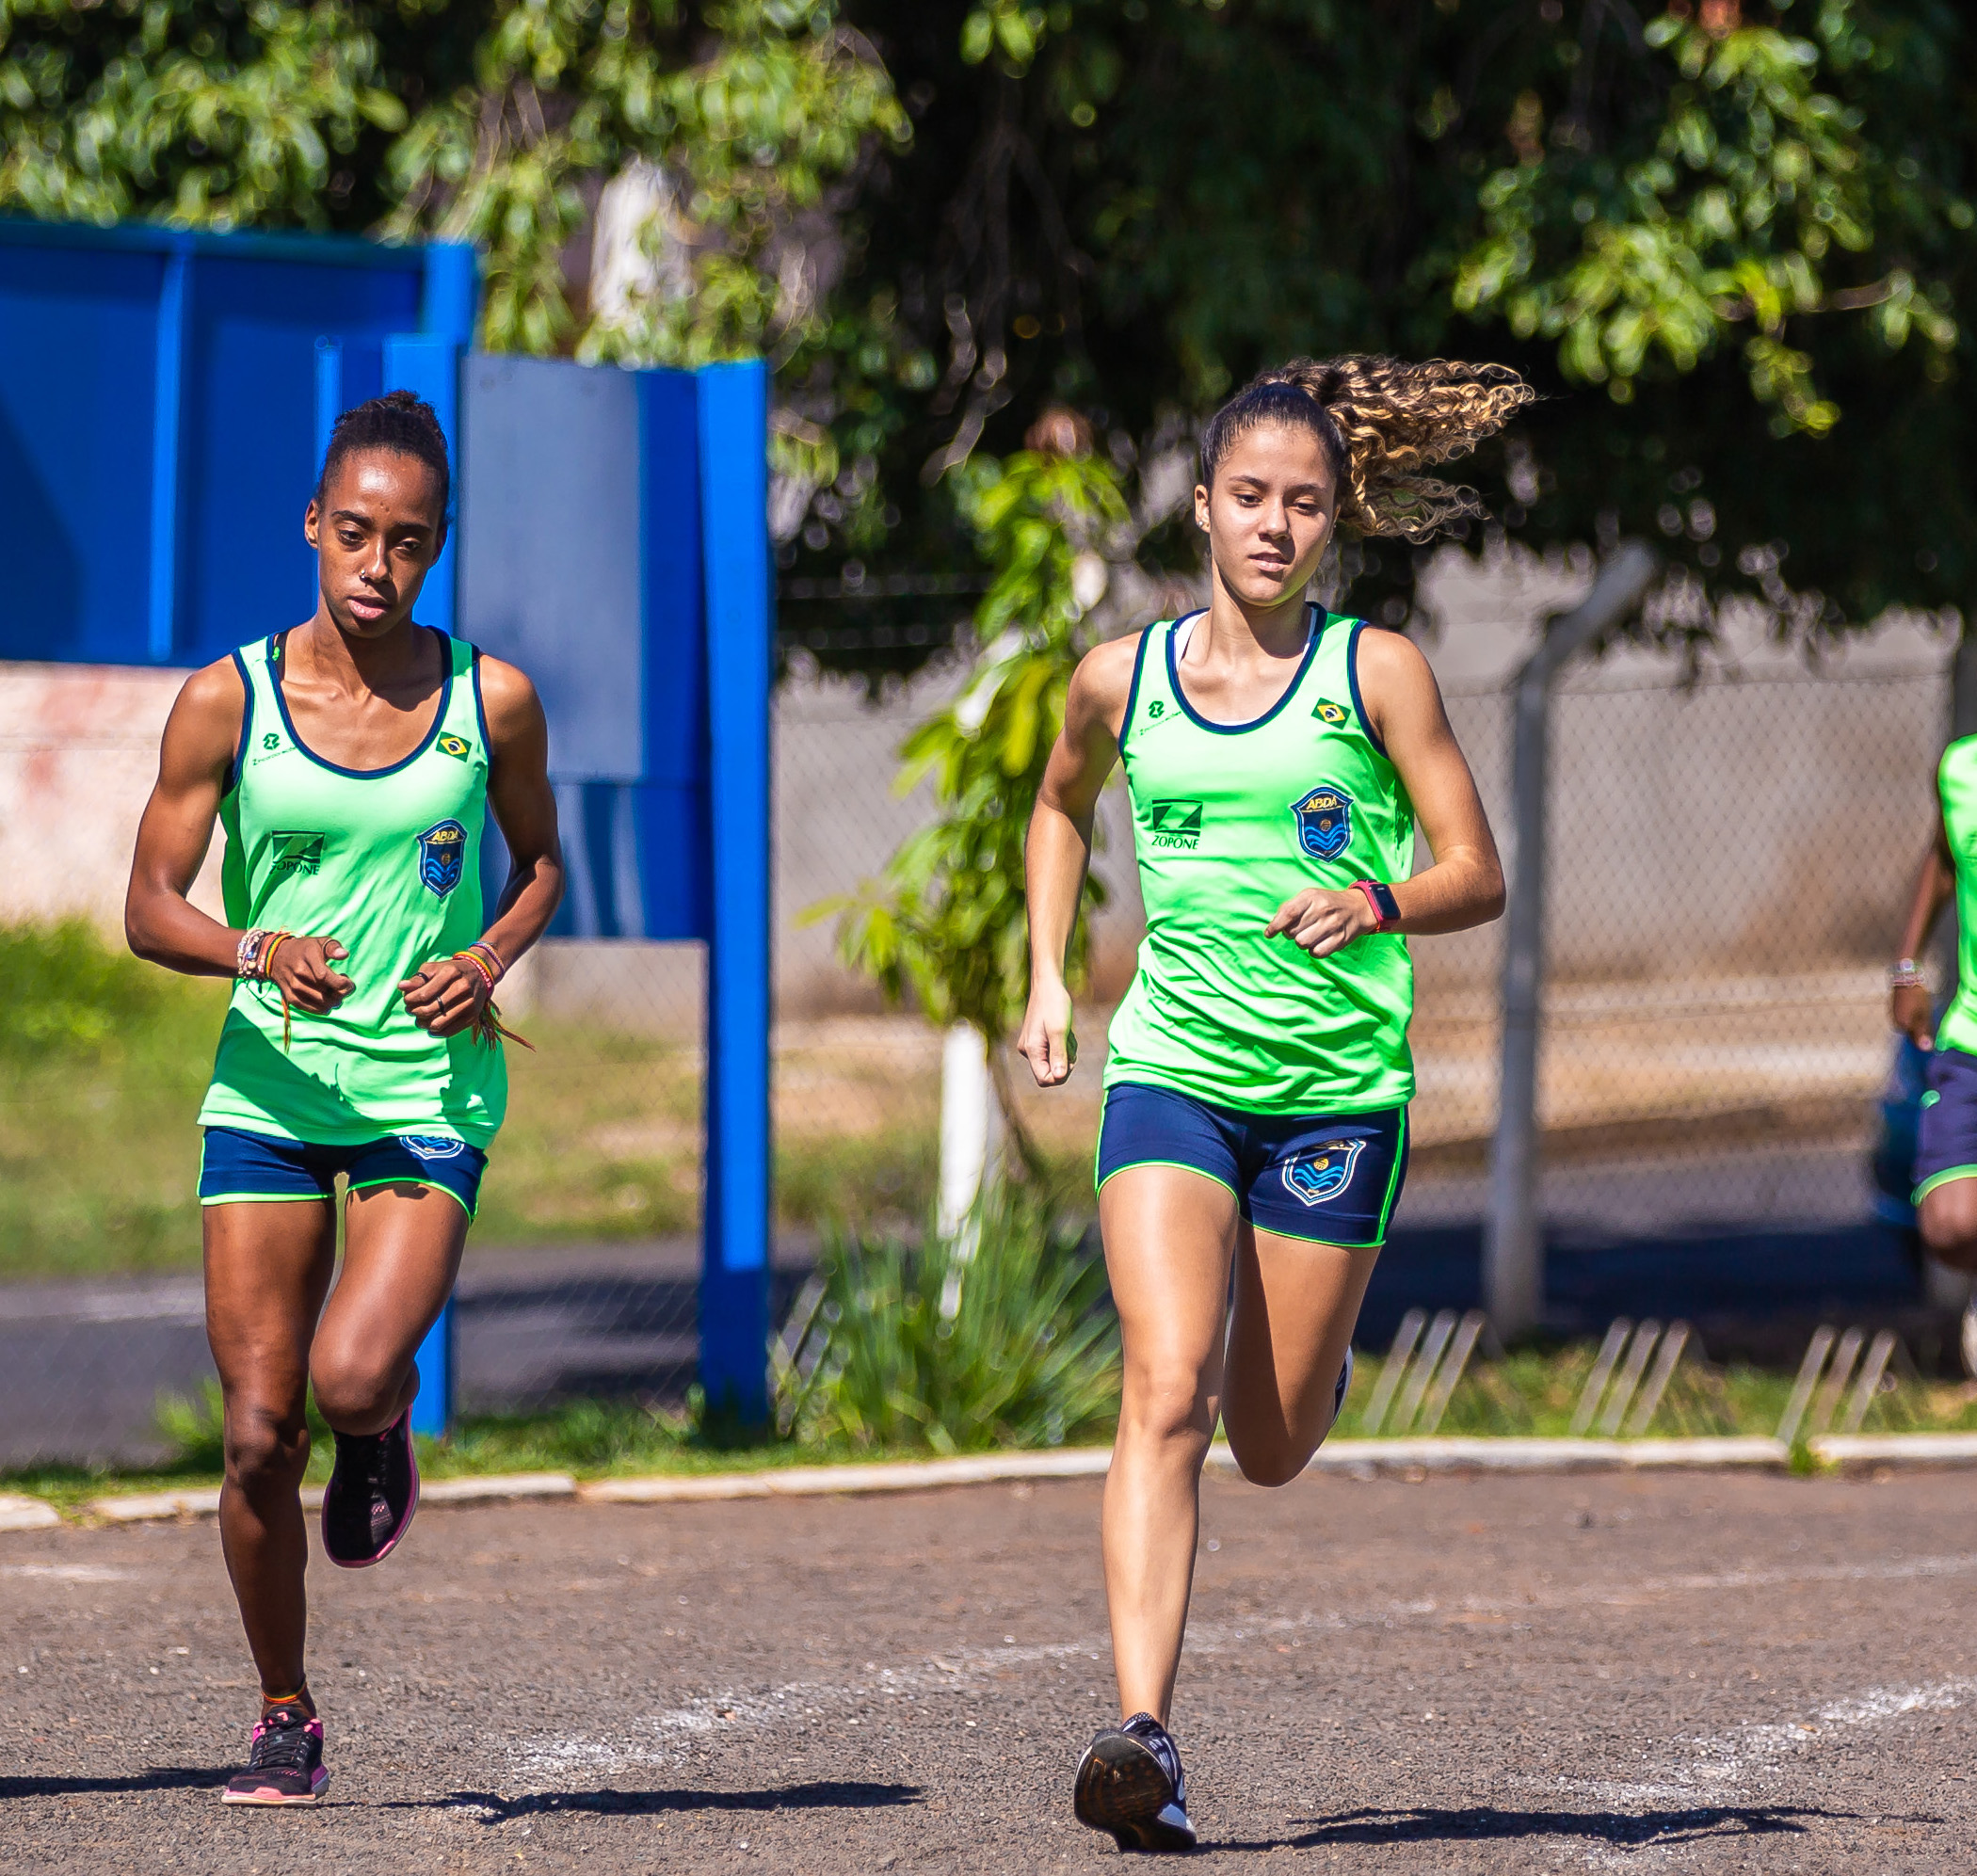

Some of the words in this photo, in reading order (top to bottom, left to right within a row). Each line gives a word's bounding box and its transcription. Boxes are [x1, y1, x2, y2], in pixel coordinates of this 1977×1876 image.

[1306, 796, 1337, 810] ABDA
[431, 830, 458, 842] ABDA
[1151, 834, 1200, 850] ZOPONE
